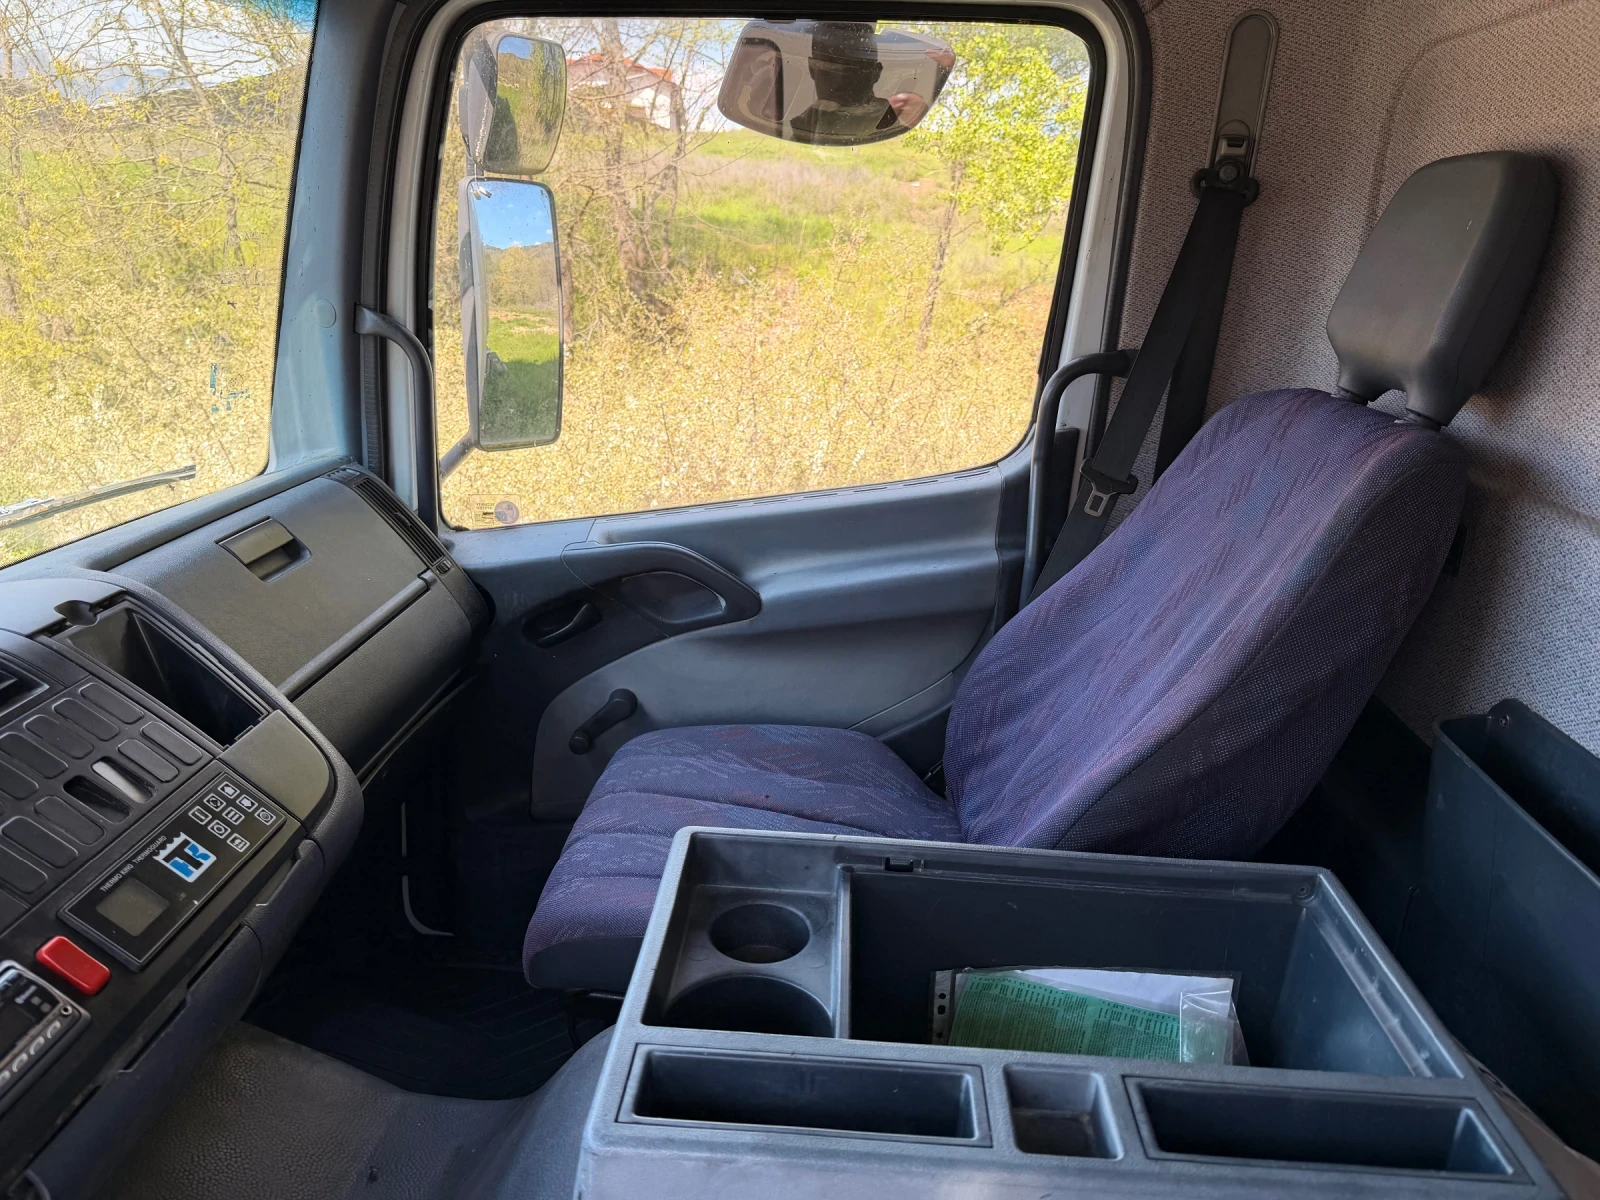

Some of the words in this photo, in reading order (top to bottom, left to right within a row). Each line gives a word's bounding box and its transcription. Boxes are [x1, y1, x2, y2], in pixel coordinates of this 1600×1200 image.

[100, 873, 123, 892] THERMO
[120, 863, 134, 876] KING
[132, 835, 167, 864] THERMOGUARD
